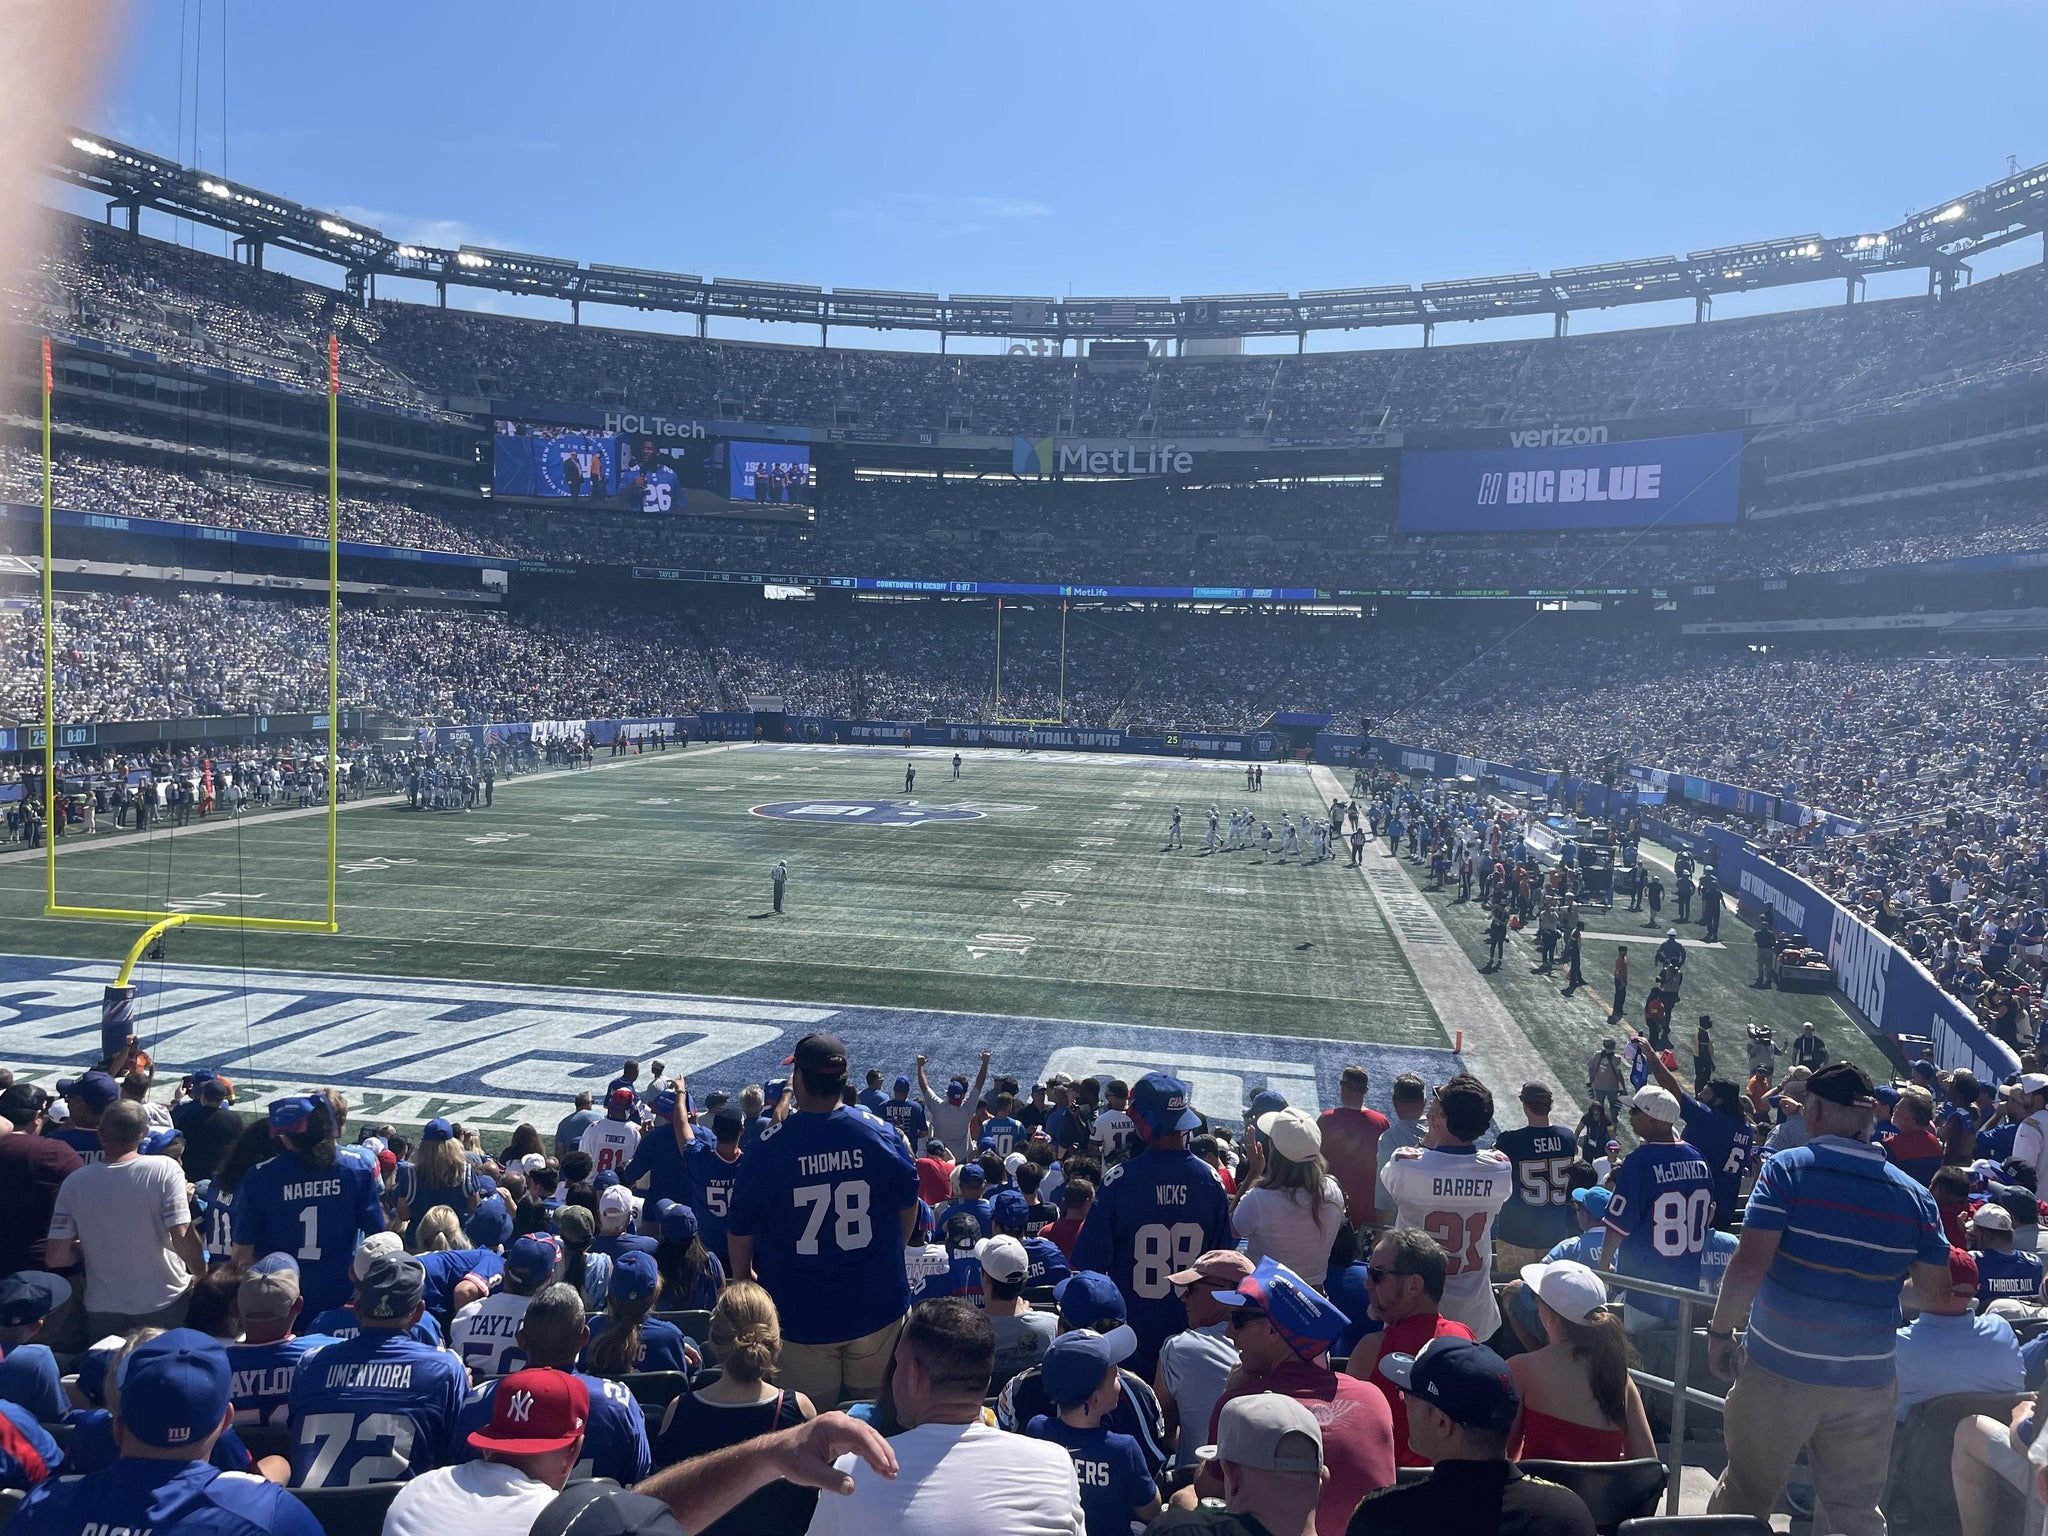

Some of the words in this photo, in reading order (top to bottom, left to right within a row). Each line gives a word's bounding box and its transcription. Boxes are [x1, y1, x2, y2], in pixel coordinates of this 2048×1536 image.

[605, 412, 706, 439] HCLTech
[1509, 424, 1608, 448] verizon
[1059, 443, 1194, 475] MetLife
[1506, 470, 1555, 504] BIG
[1558, 464, 1662, 502] BLUE
[643, 483, 672, 513] 26
[876, 580, 914, 589] COUNTDOWN
[922, 582, 947, 590] KICKOFF
[955, 583, 970, 592] 0:07
[1073, 588, 1108, 597] MetLife
[67, 729, 87, 743] 0:07
[531, 720, 587, 744] GIANTS
[1015, 730, 1074, 745] FOTBALL
[1167, 735, 1178, 744] 25
[1828, 906, 1892, 1028] GIANTS
[1111, 1121, 1136, 1131] MANNI
[1533, 1136, 1562, 1154] SEAU
[598, 1148, 624, 1176] 81
[797, 1148, 864, 1176] THOMAS
[1653, 1160, 1713, 1184] McCONKEY
[1722, 1147, 1745, 1174] 6
[283, 1178, 341, 1200] NABERS
[710, 1178, 737, 1188] TAYL
[1432, 1177, 1493, 1197] BARBER
[1518, 1157, 1574, 1207] 55
[1156, 1184, 1187, 1206] NICKS
[793, 1179, 873, 1255] 78
[1027, 1220, 1049, 1232] RBERT
[1653, 1188, 1712, 1257] 80
[208, 1208, 233, 1255] 11
[298, 1205, 322, 1260] 1
[1424, 1210, 1488, 1276] 21
[905, 1262, 945, 1281] ANTS
[1028, 1261, 1046, 1279] ERS
[1987, 1278, 2034, 1293] THIBODEAUX
[470, 1314, 526, 1338] TAYL
[230, 1364, 296, 1398] AYLO
[325, 1363, 412, 1390] UMENYIORA
[506, 1389, 535, 1422] NY
[168, 1425, 190, 1442] ny
[300, 1412, 416, 1489] 72
[1078, 1460, 1110, 1486] ERS
